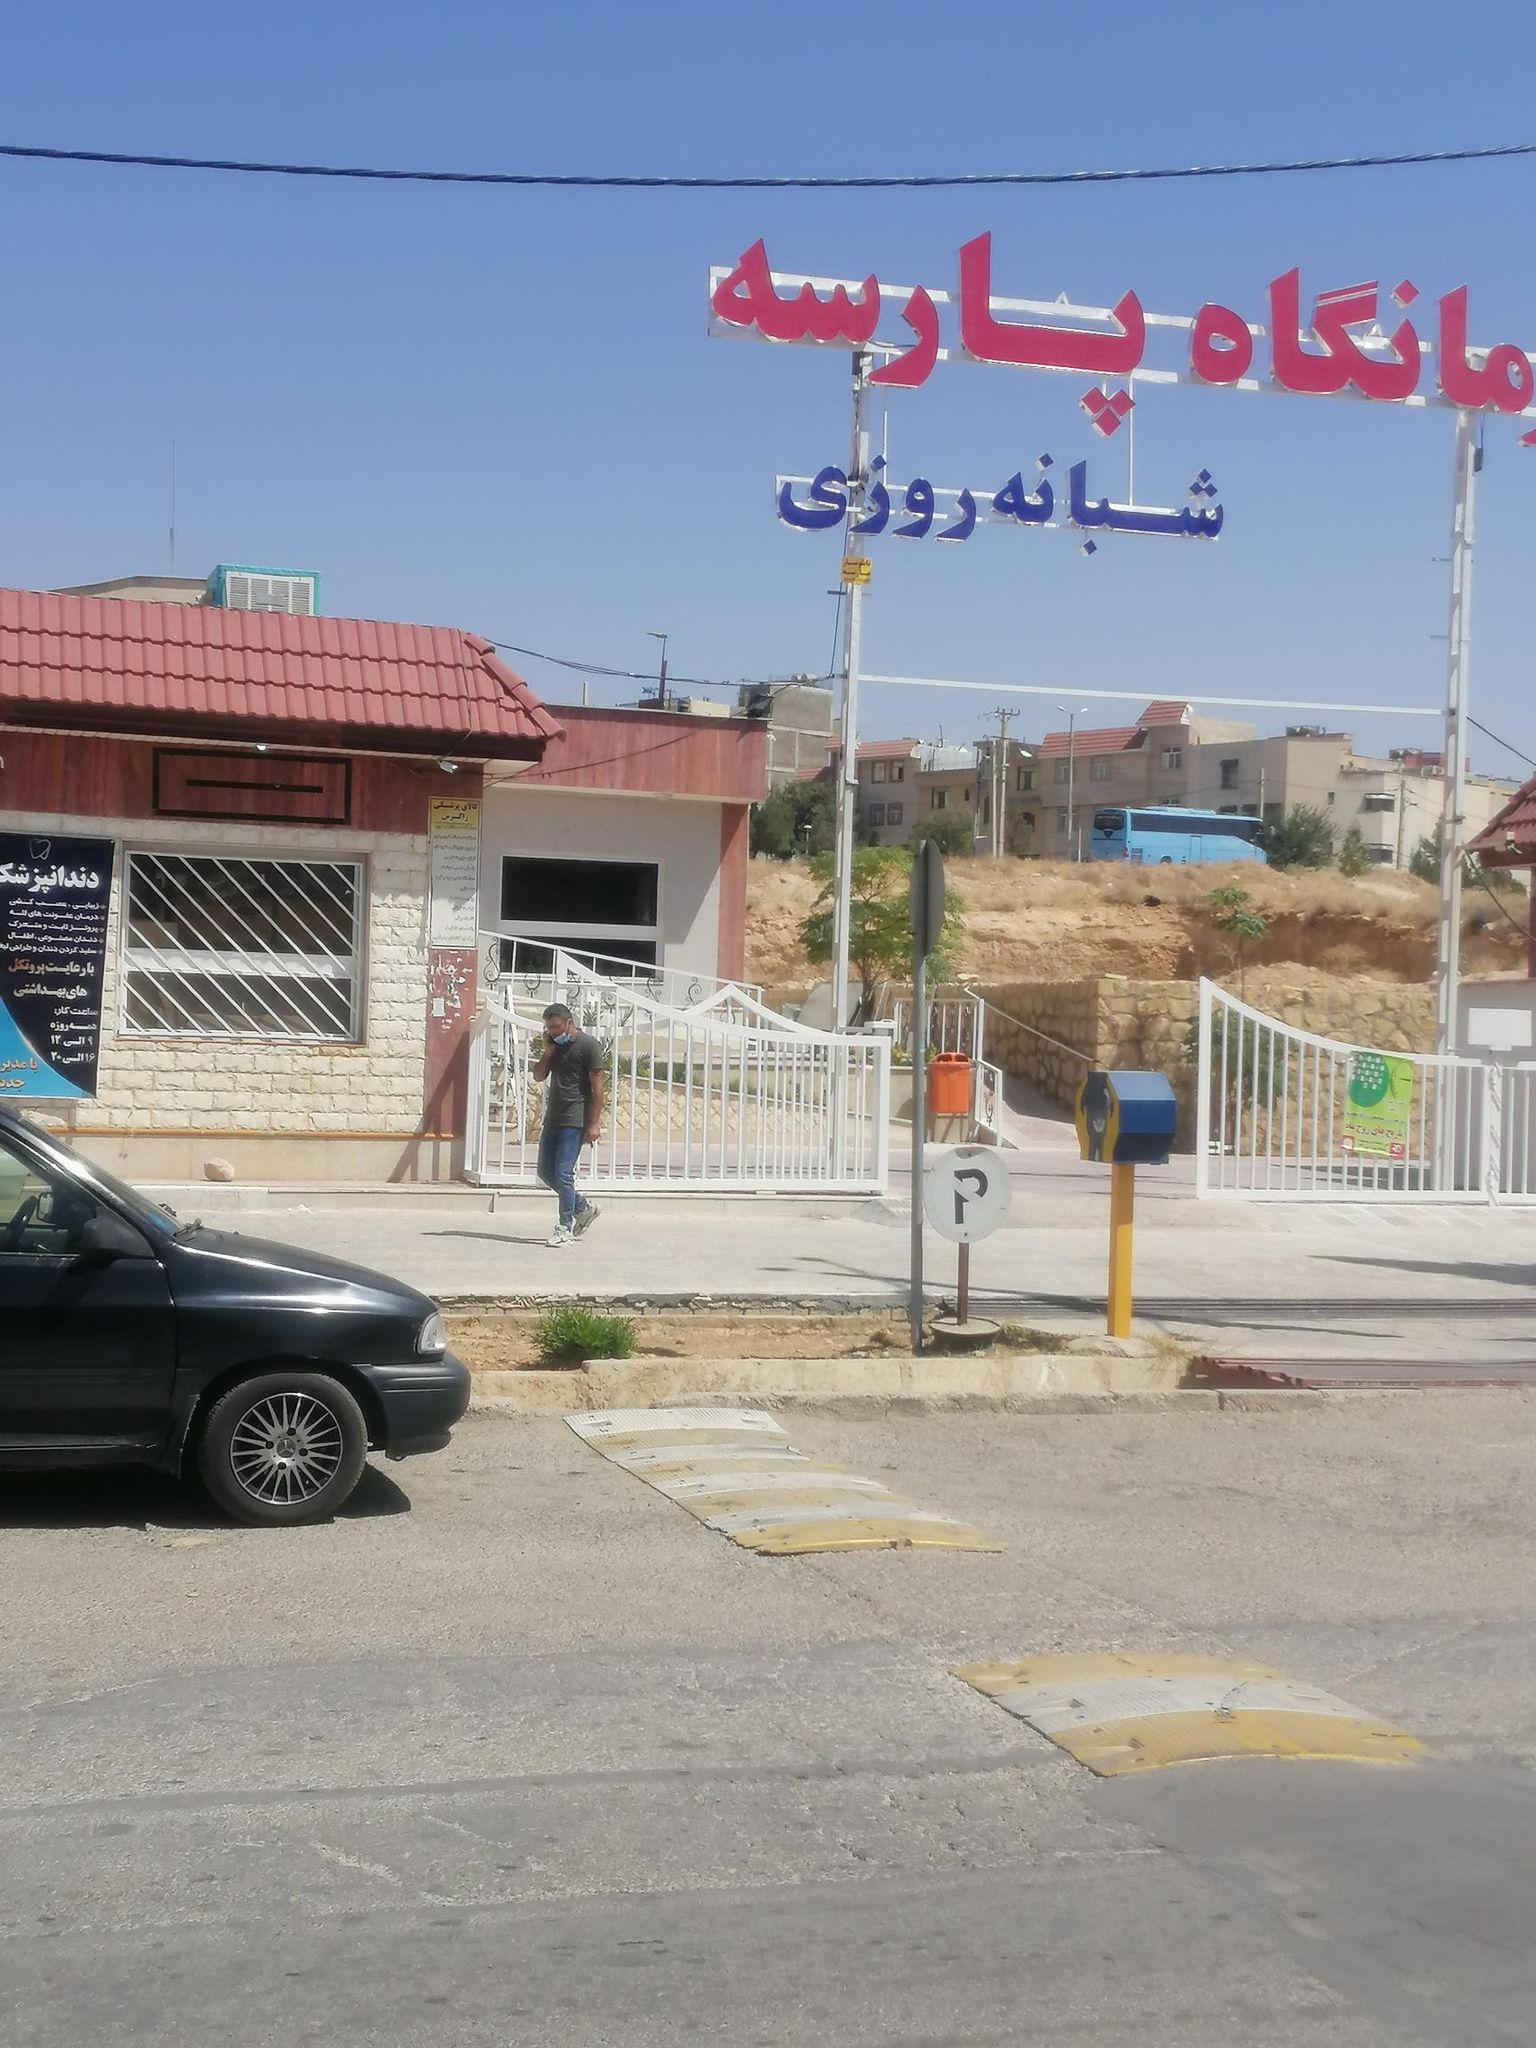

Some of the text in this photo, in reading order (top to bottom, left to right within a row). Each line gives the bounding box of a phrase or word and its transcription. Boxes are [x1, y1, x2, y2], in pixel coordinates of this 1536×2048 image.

[711, 230, 1536, 446] مانگاه پارسه
[777, 452, 1224, 557] شبانه روزی
[0, 862, 99, 894] دندانپزشک
